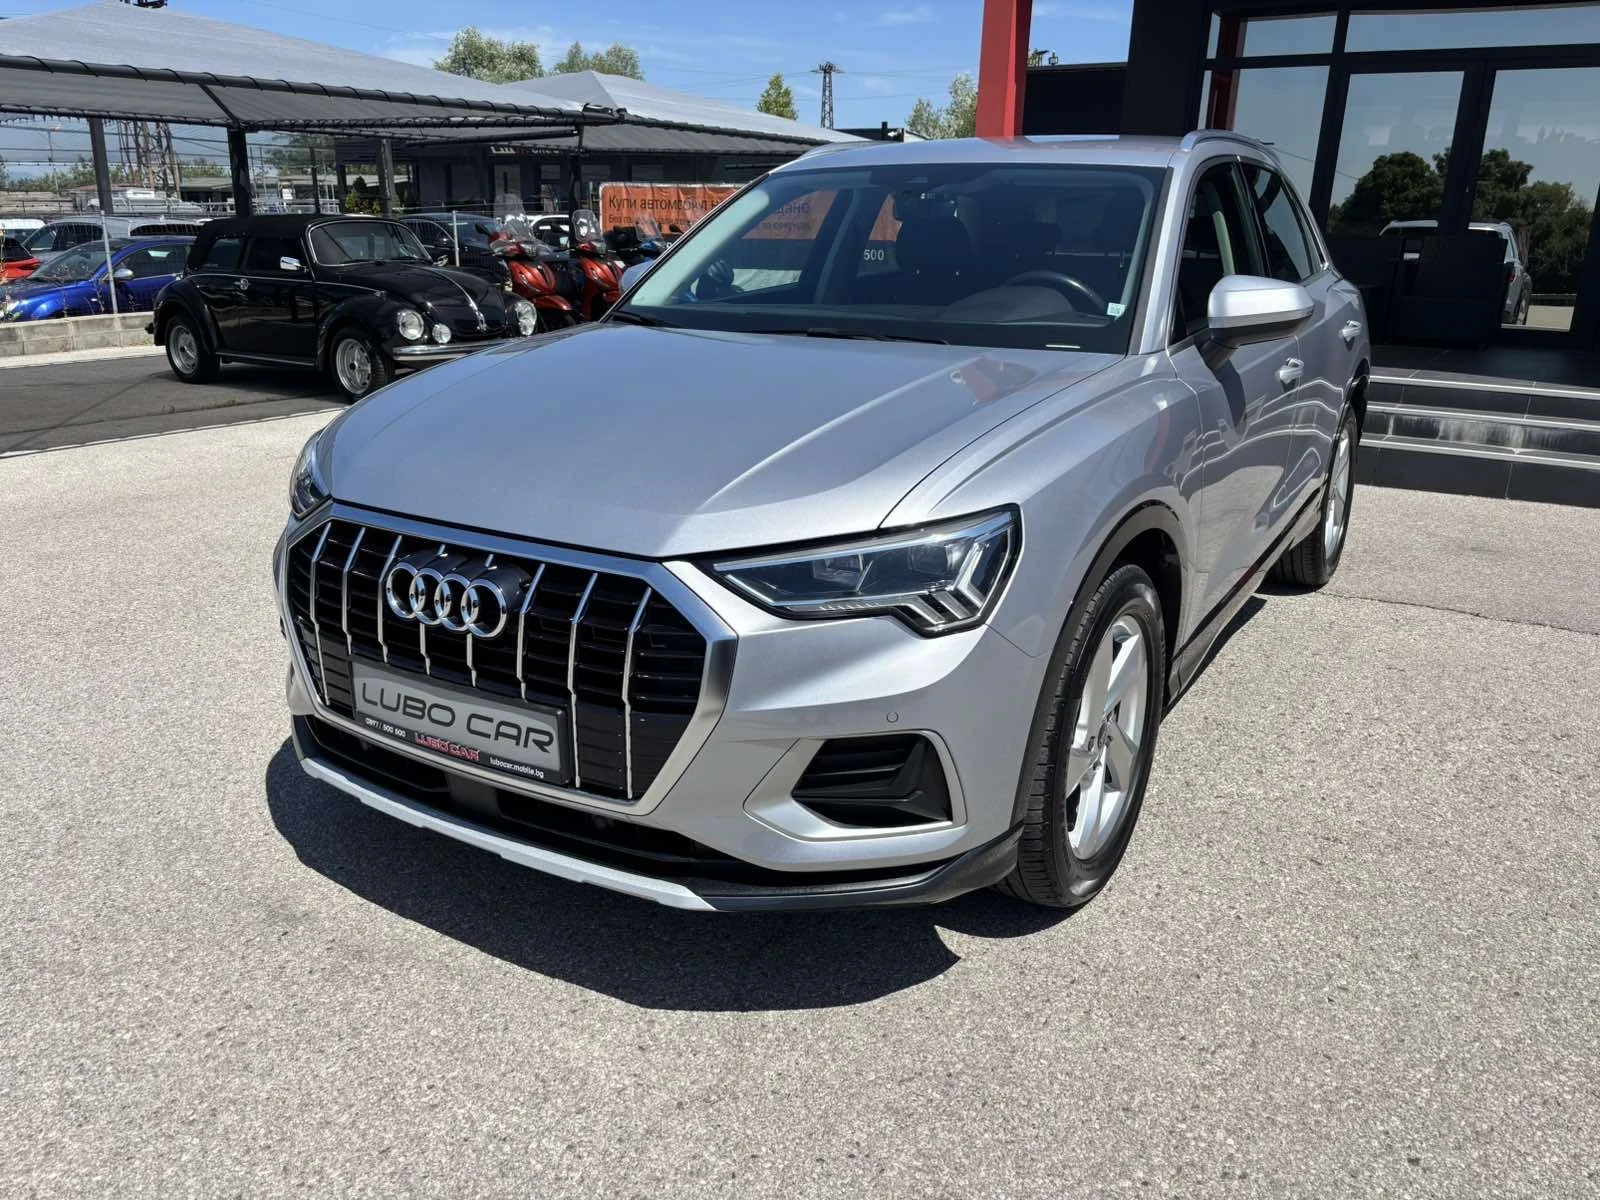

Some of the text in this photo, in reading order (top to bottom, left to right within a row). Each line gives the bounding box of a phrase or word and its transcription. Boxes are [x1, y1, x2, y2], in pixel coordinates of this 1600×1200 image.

[609, 196, 636, 211] Купи
[640, 196, 707, 211] автомобил
[863, 249, 885, 261] 500
[362, 683, 554, 753] LUBO CAR
[415, 732, 480, 761] LUBO CAR
[489, 756, 545, 779] lubocar.mobile.bg
